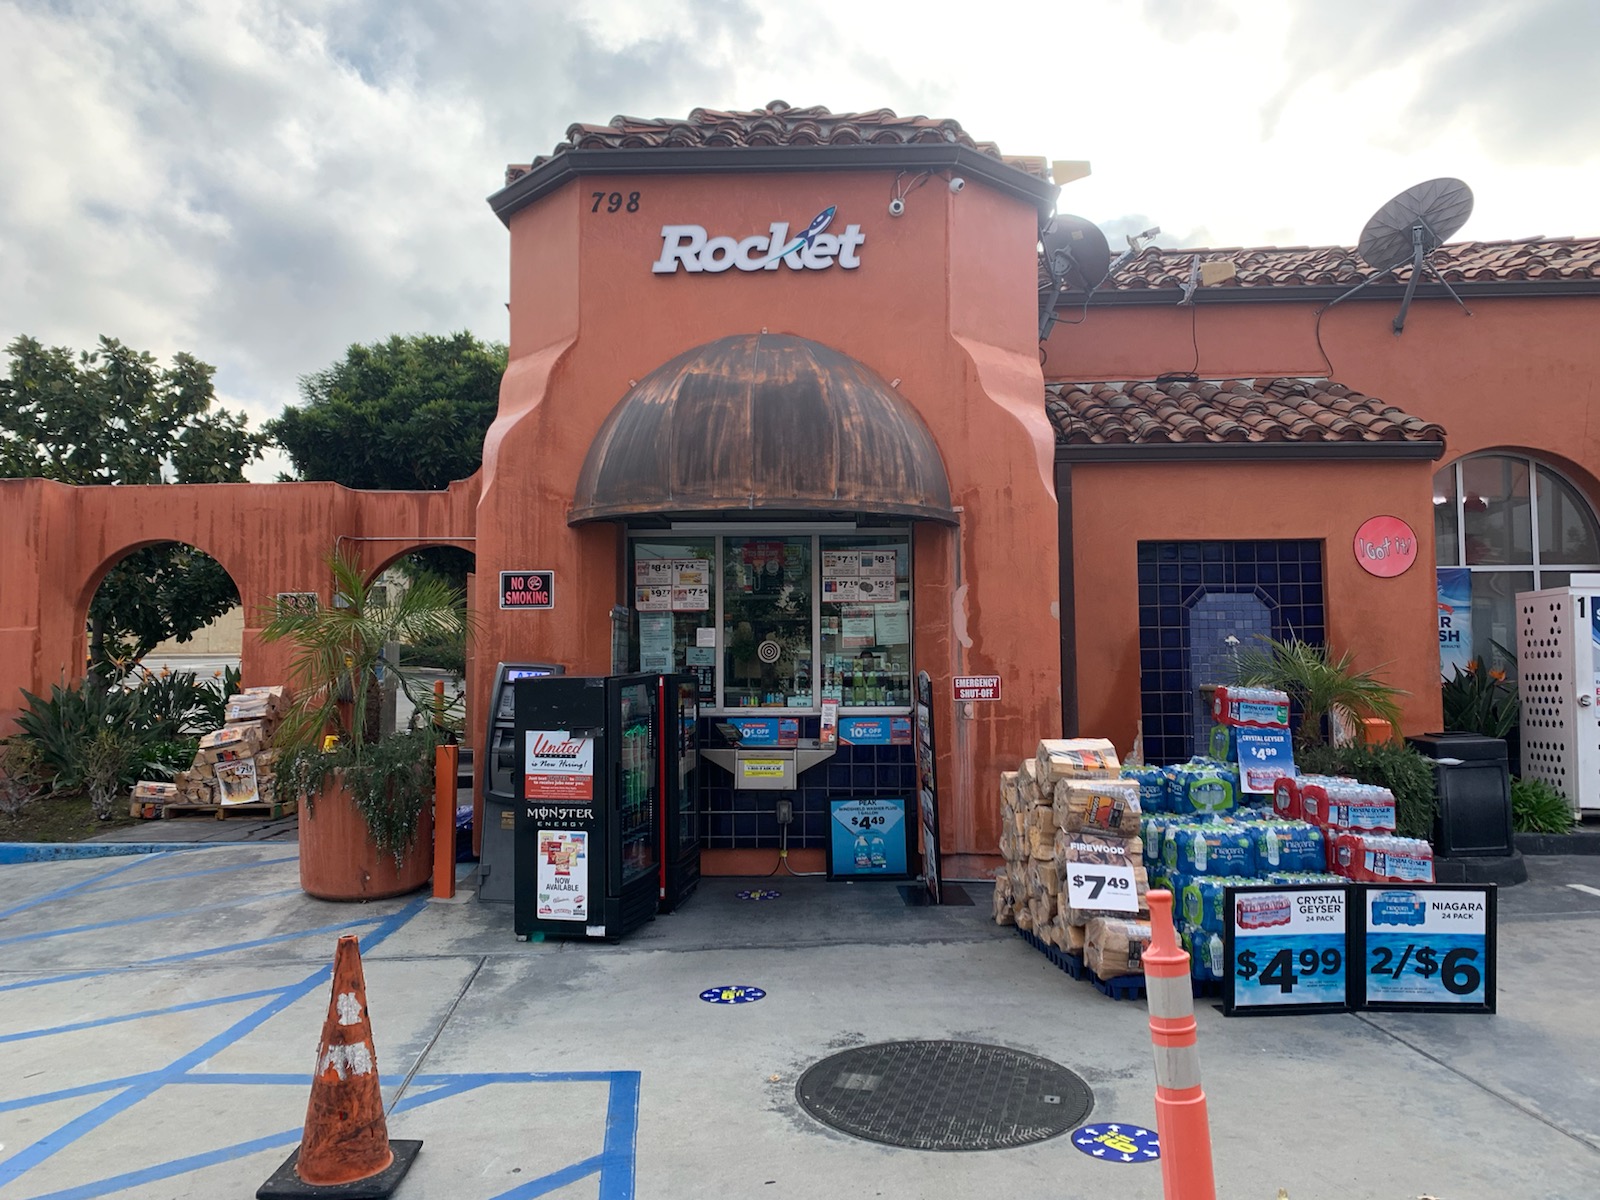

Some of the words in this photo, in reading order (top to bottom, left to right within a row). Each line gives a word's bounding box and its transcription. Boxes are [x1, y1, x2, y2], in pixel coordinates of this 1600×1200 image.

[591, 191, 641, 213] 798
[651, 214, 866, 275] Rocket
[1366, 536, 1392, 560] Got
[511, 577, 524, 590] NO
[505, 591, 548, 604] SMOKING
[955, 678, 998, 688] EMERGENCY
[959, 688, 994, 698] SHUT-OFF
[533, 733, 586, 756] United
[559, 760, 588, 770] Hiring!
[527, 807, 594, 820] MONSTER
[1070, 843, 1125, 854] FIREWOOD
[1214, 845, 1244, 856] niagara
[1285, 840, 1315, 850] niagara
[1296, 895, 1344, 905] CRYSTAL
[1299, 904, 1341, 914] GEYSER
[1386, 905, 1409, 915] niagara
[1432, 902, 1483, 911] NIAGARA
[1236, 948, 1342, 994] $499
[1371, 944, 1481, 995] 2/$6
